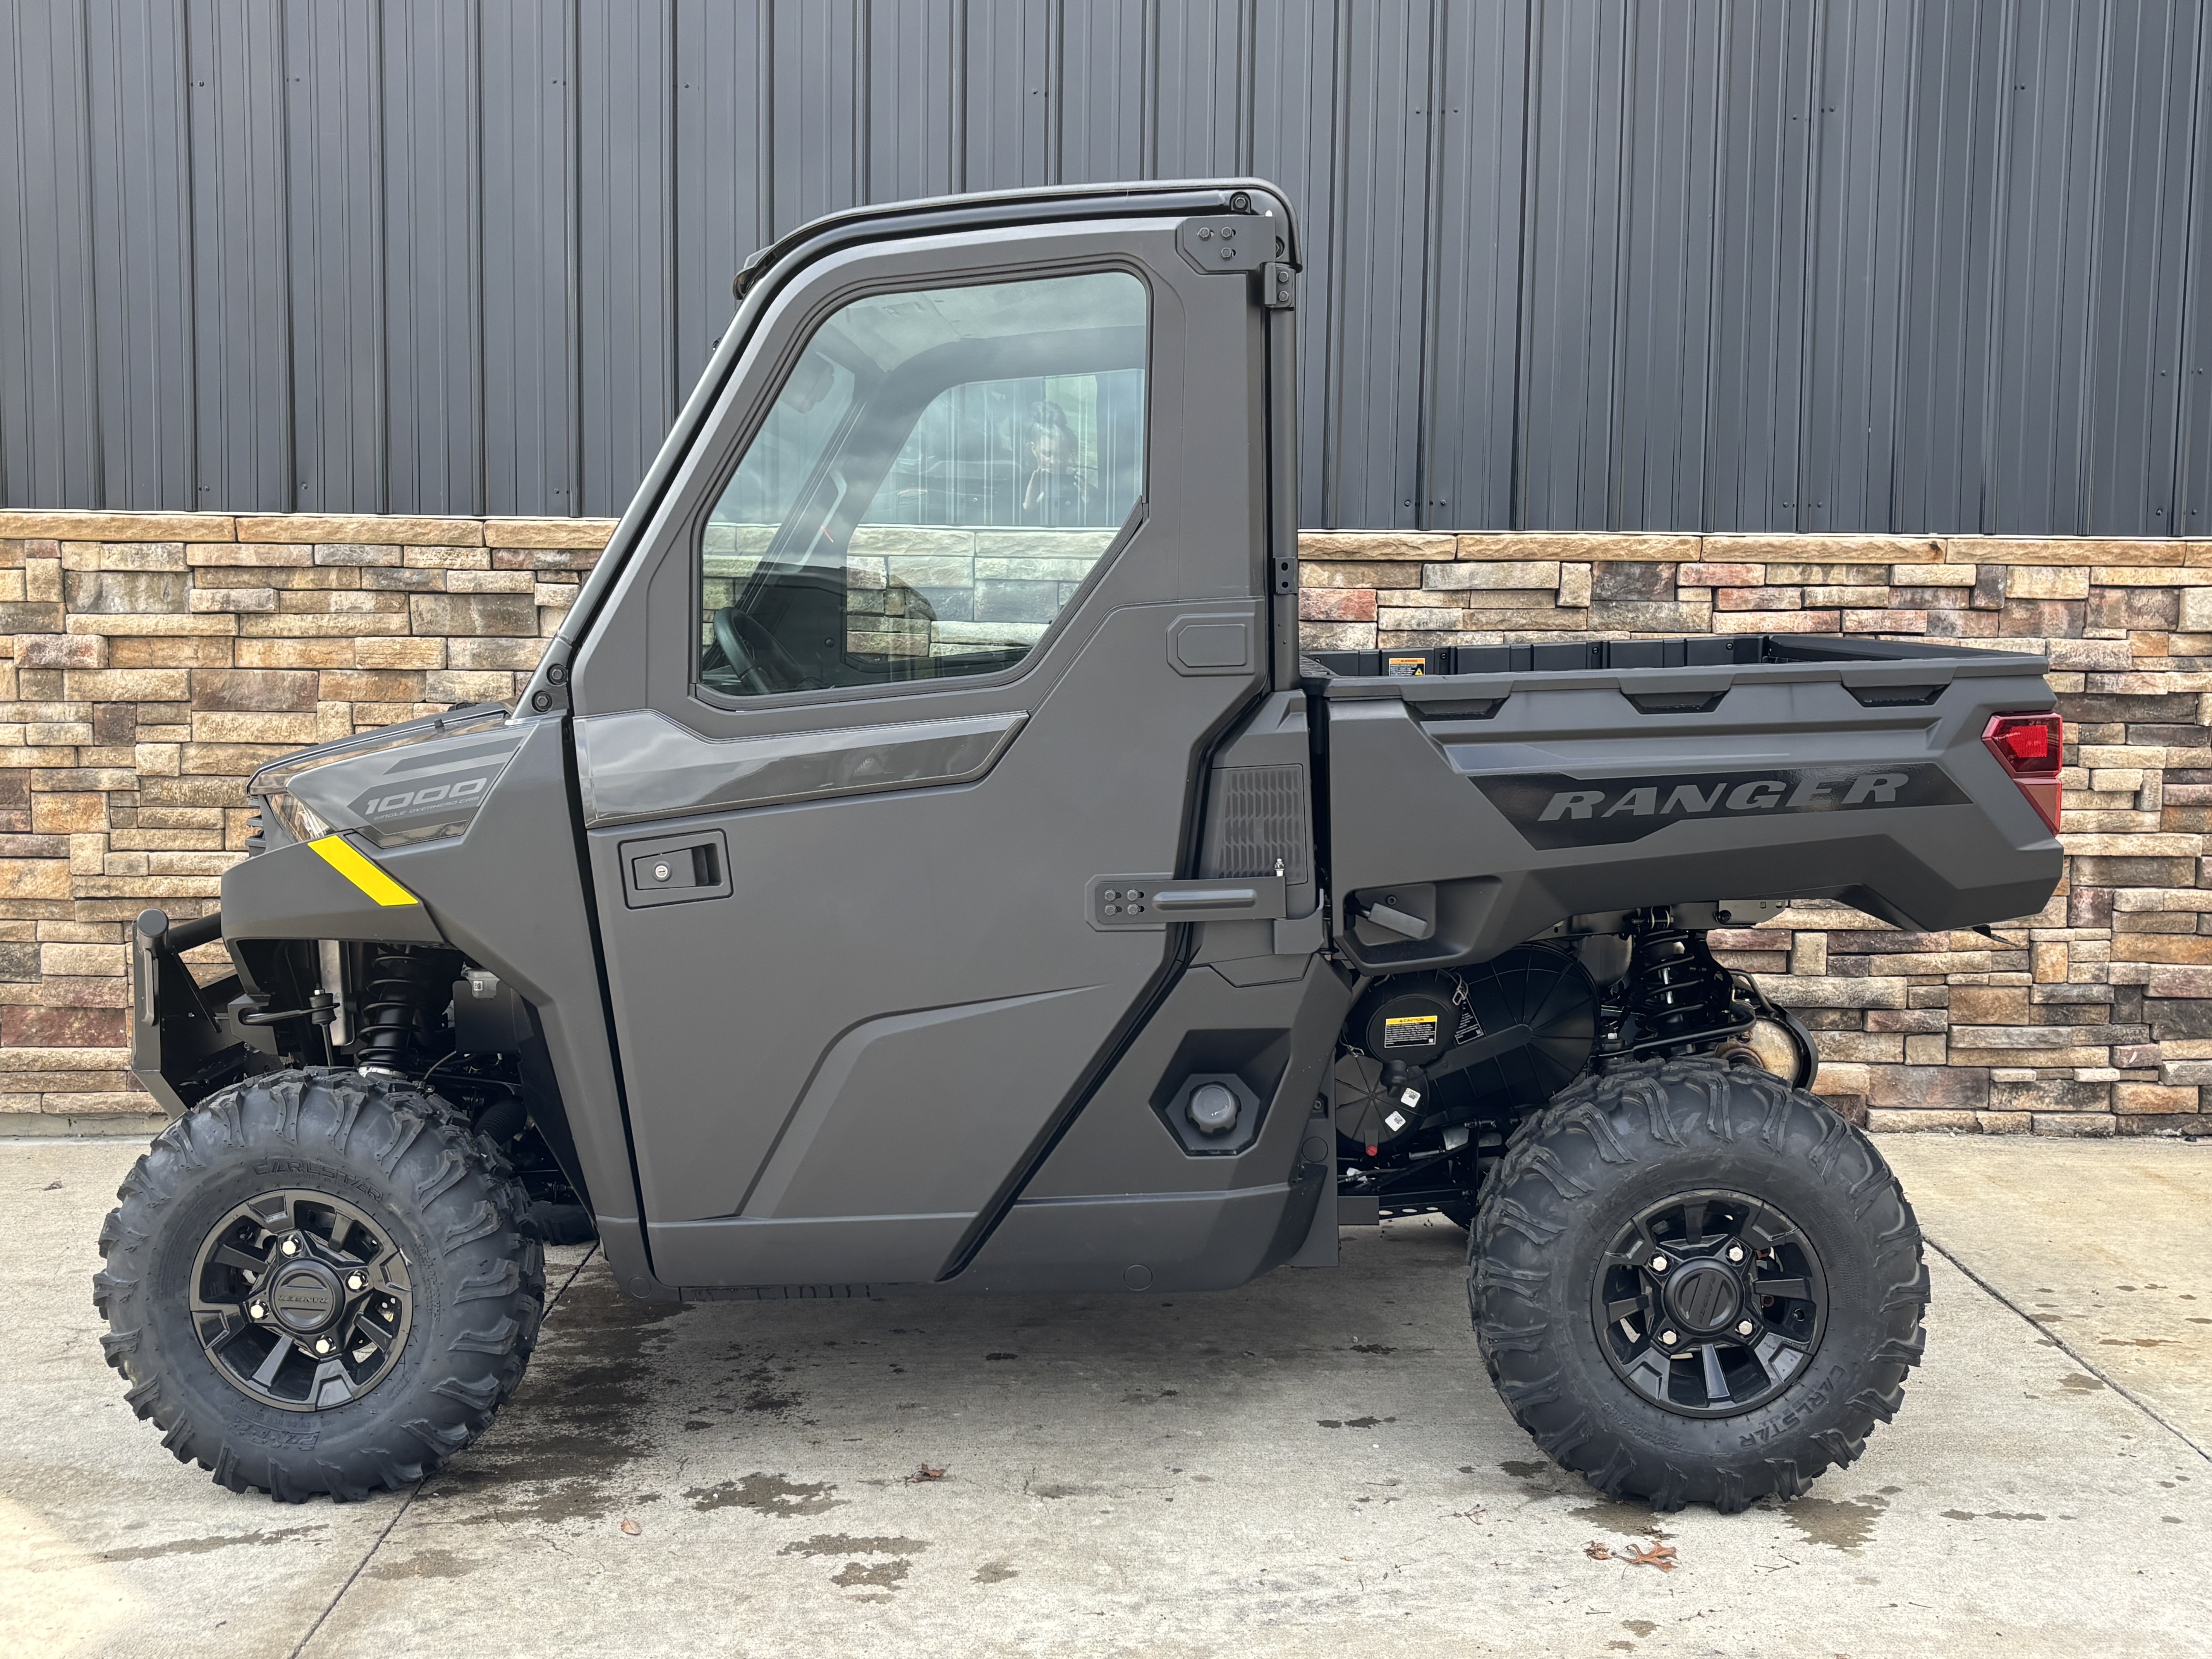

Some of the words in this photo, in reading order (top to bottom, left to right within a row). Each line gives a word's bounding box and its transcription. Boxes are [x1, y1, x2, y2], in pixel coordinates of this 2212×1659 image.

[365, 778, 487, 815] 1000
[373, 810, 406, 821] SINGLE
[409, 800, 458, 814] OVERHEAD
[1537, 774, 1909, 821] RANGER
[253, 1160, 383, 1203] CARLSTAR
[1738, 1365, 1846, 1448] CARLSTAR
